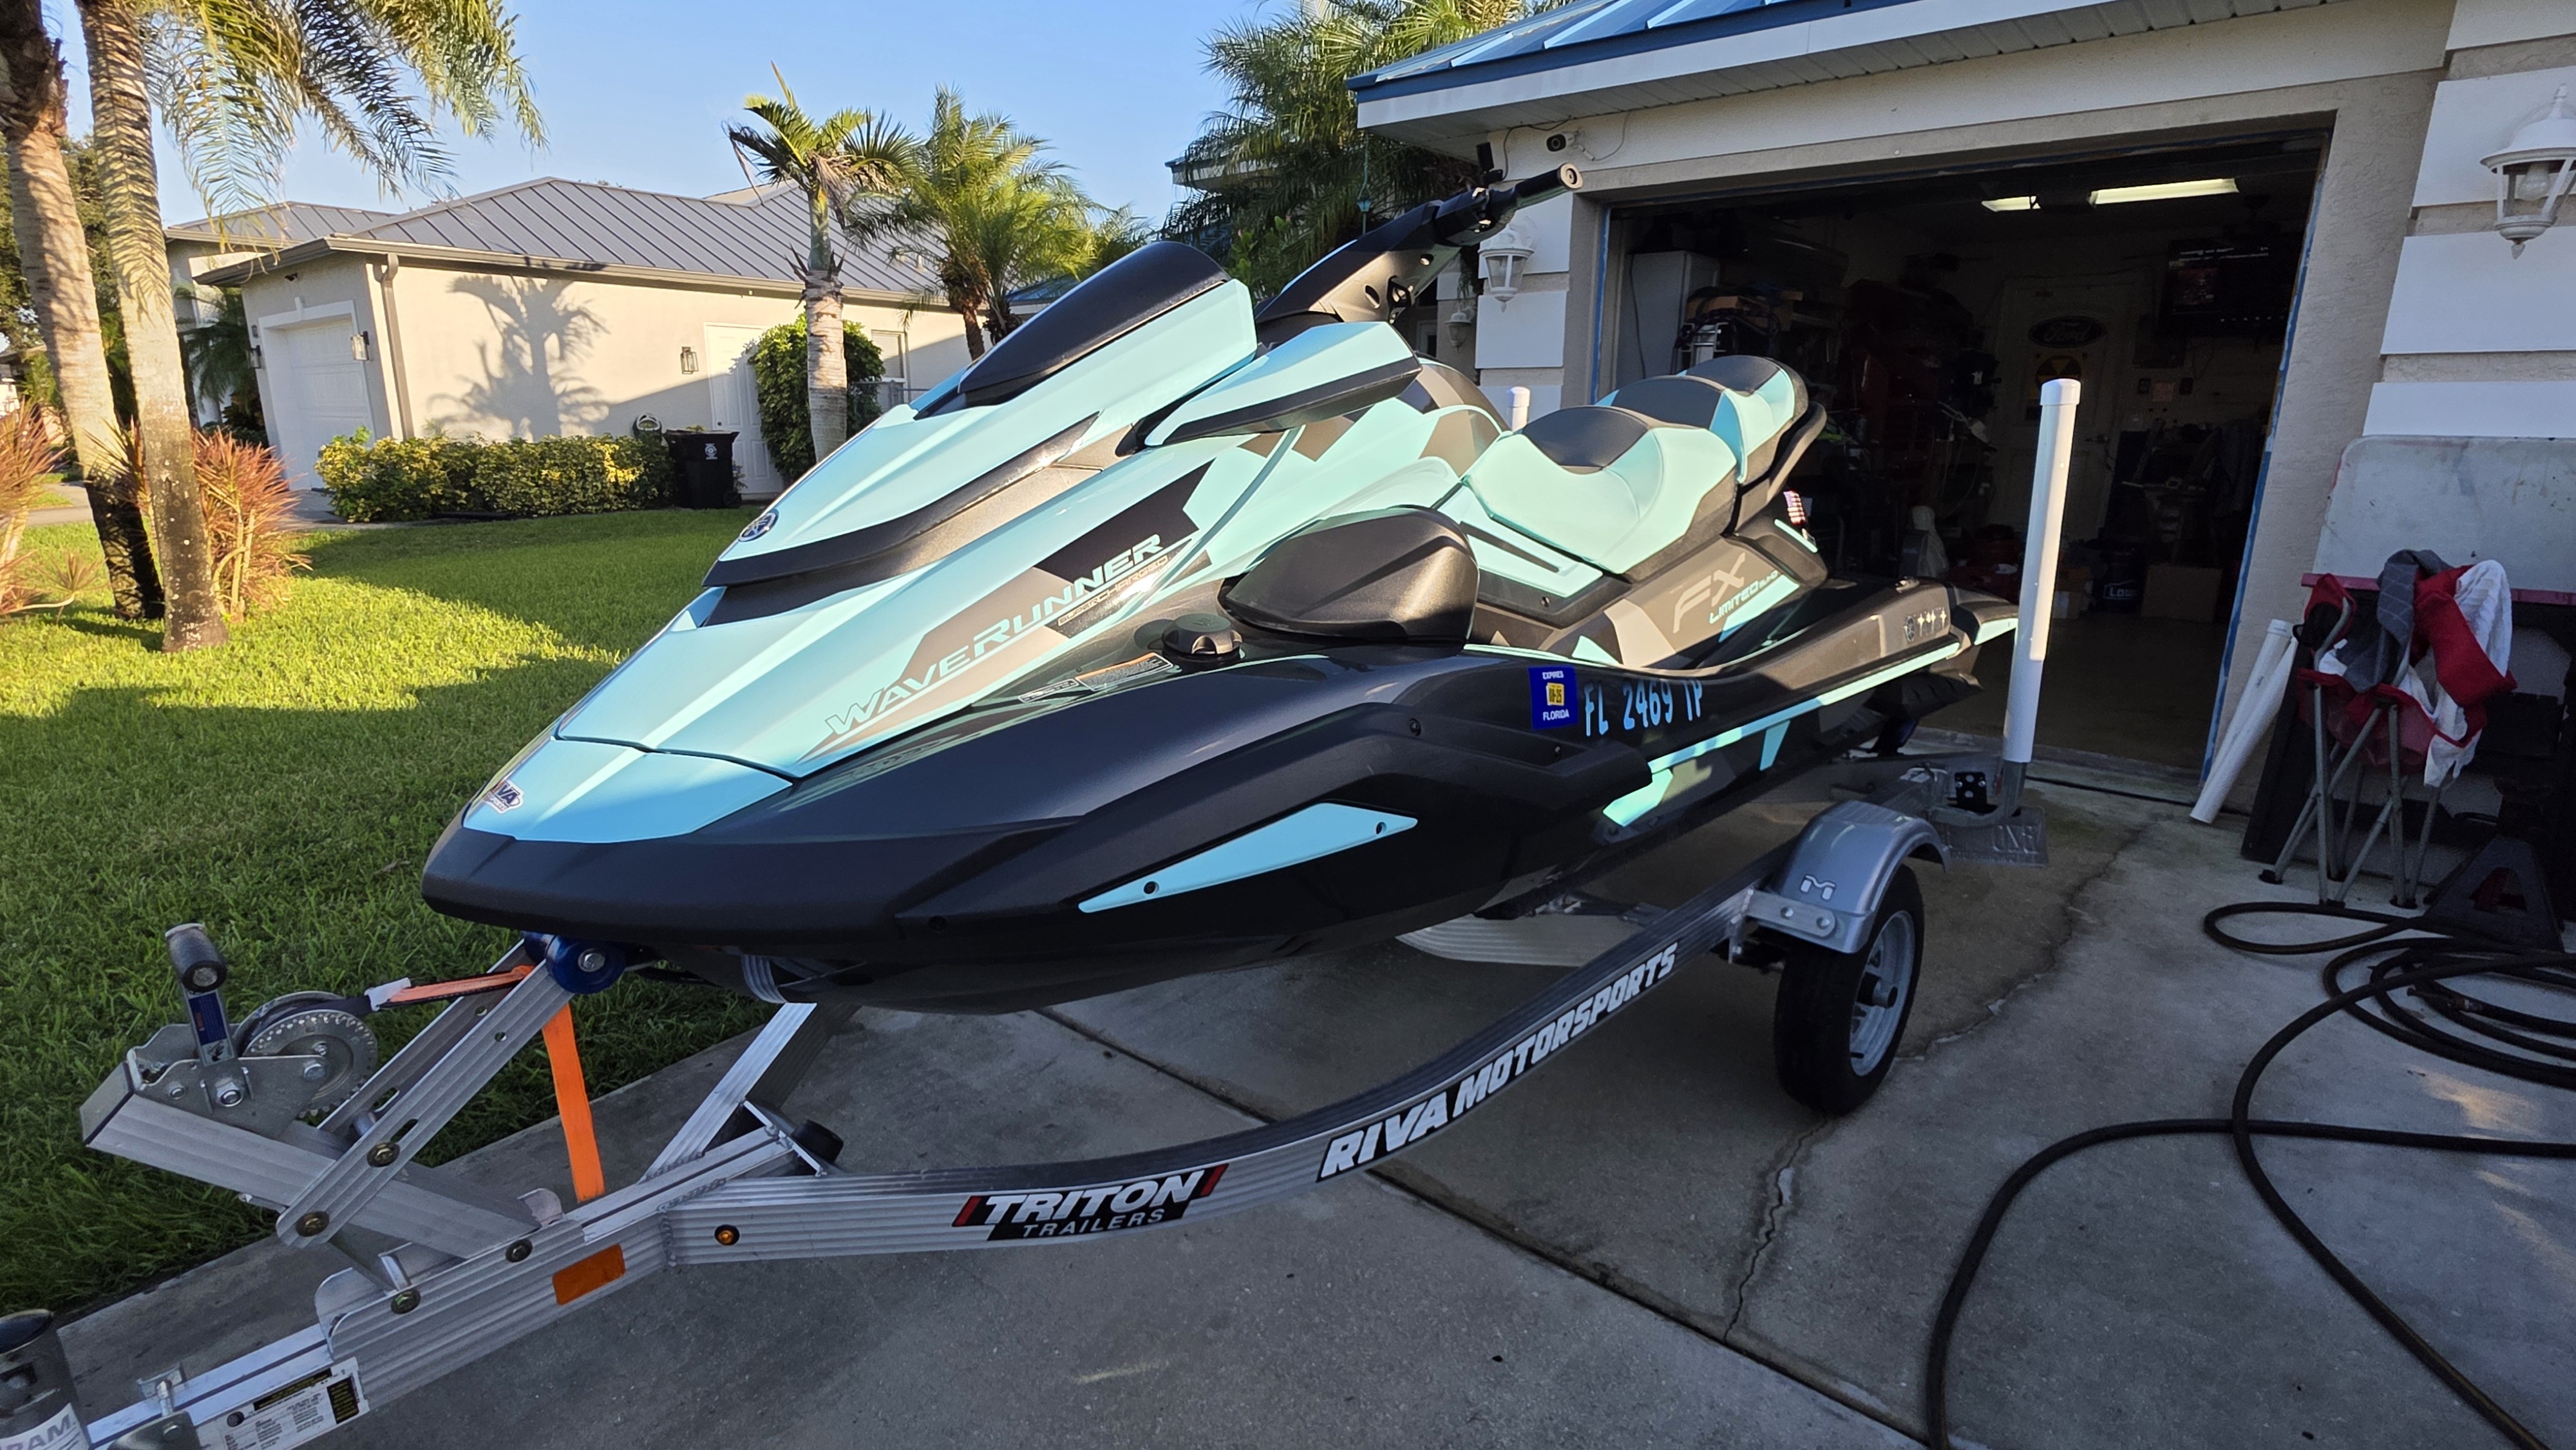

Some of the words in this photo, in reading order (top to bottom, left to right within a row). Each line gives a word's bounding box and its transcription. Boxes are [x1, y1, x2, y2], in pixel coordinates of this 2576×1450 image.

[1058, 555, 1168, 626] SUPERCHARGED
[1673, 552, 1746, 634] FX
[1709, 580, 1759, 625] LIMITED
[825, 534, 1163, 735] WAVERUNNER
[1543, 710, 1569, 720] FLORIDA
[1584, 683, 1609, 737] FL
[1623, 678, 1673, 730] 2469
[1321, 1091, 1448, 1178] RIVA
[1453, 943, 1678, 1118] MOTORSPORTS
[984, 1169, 1206, 1225] TRITON
[1023, 1210, 1164, 1238] TRAILERS
